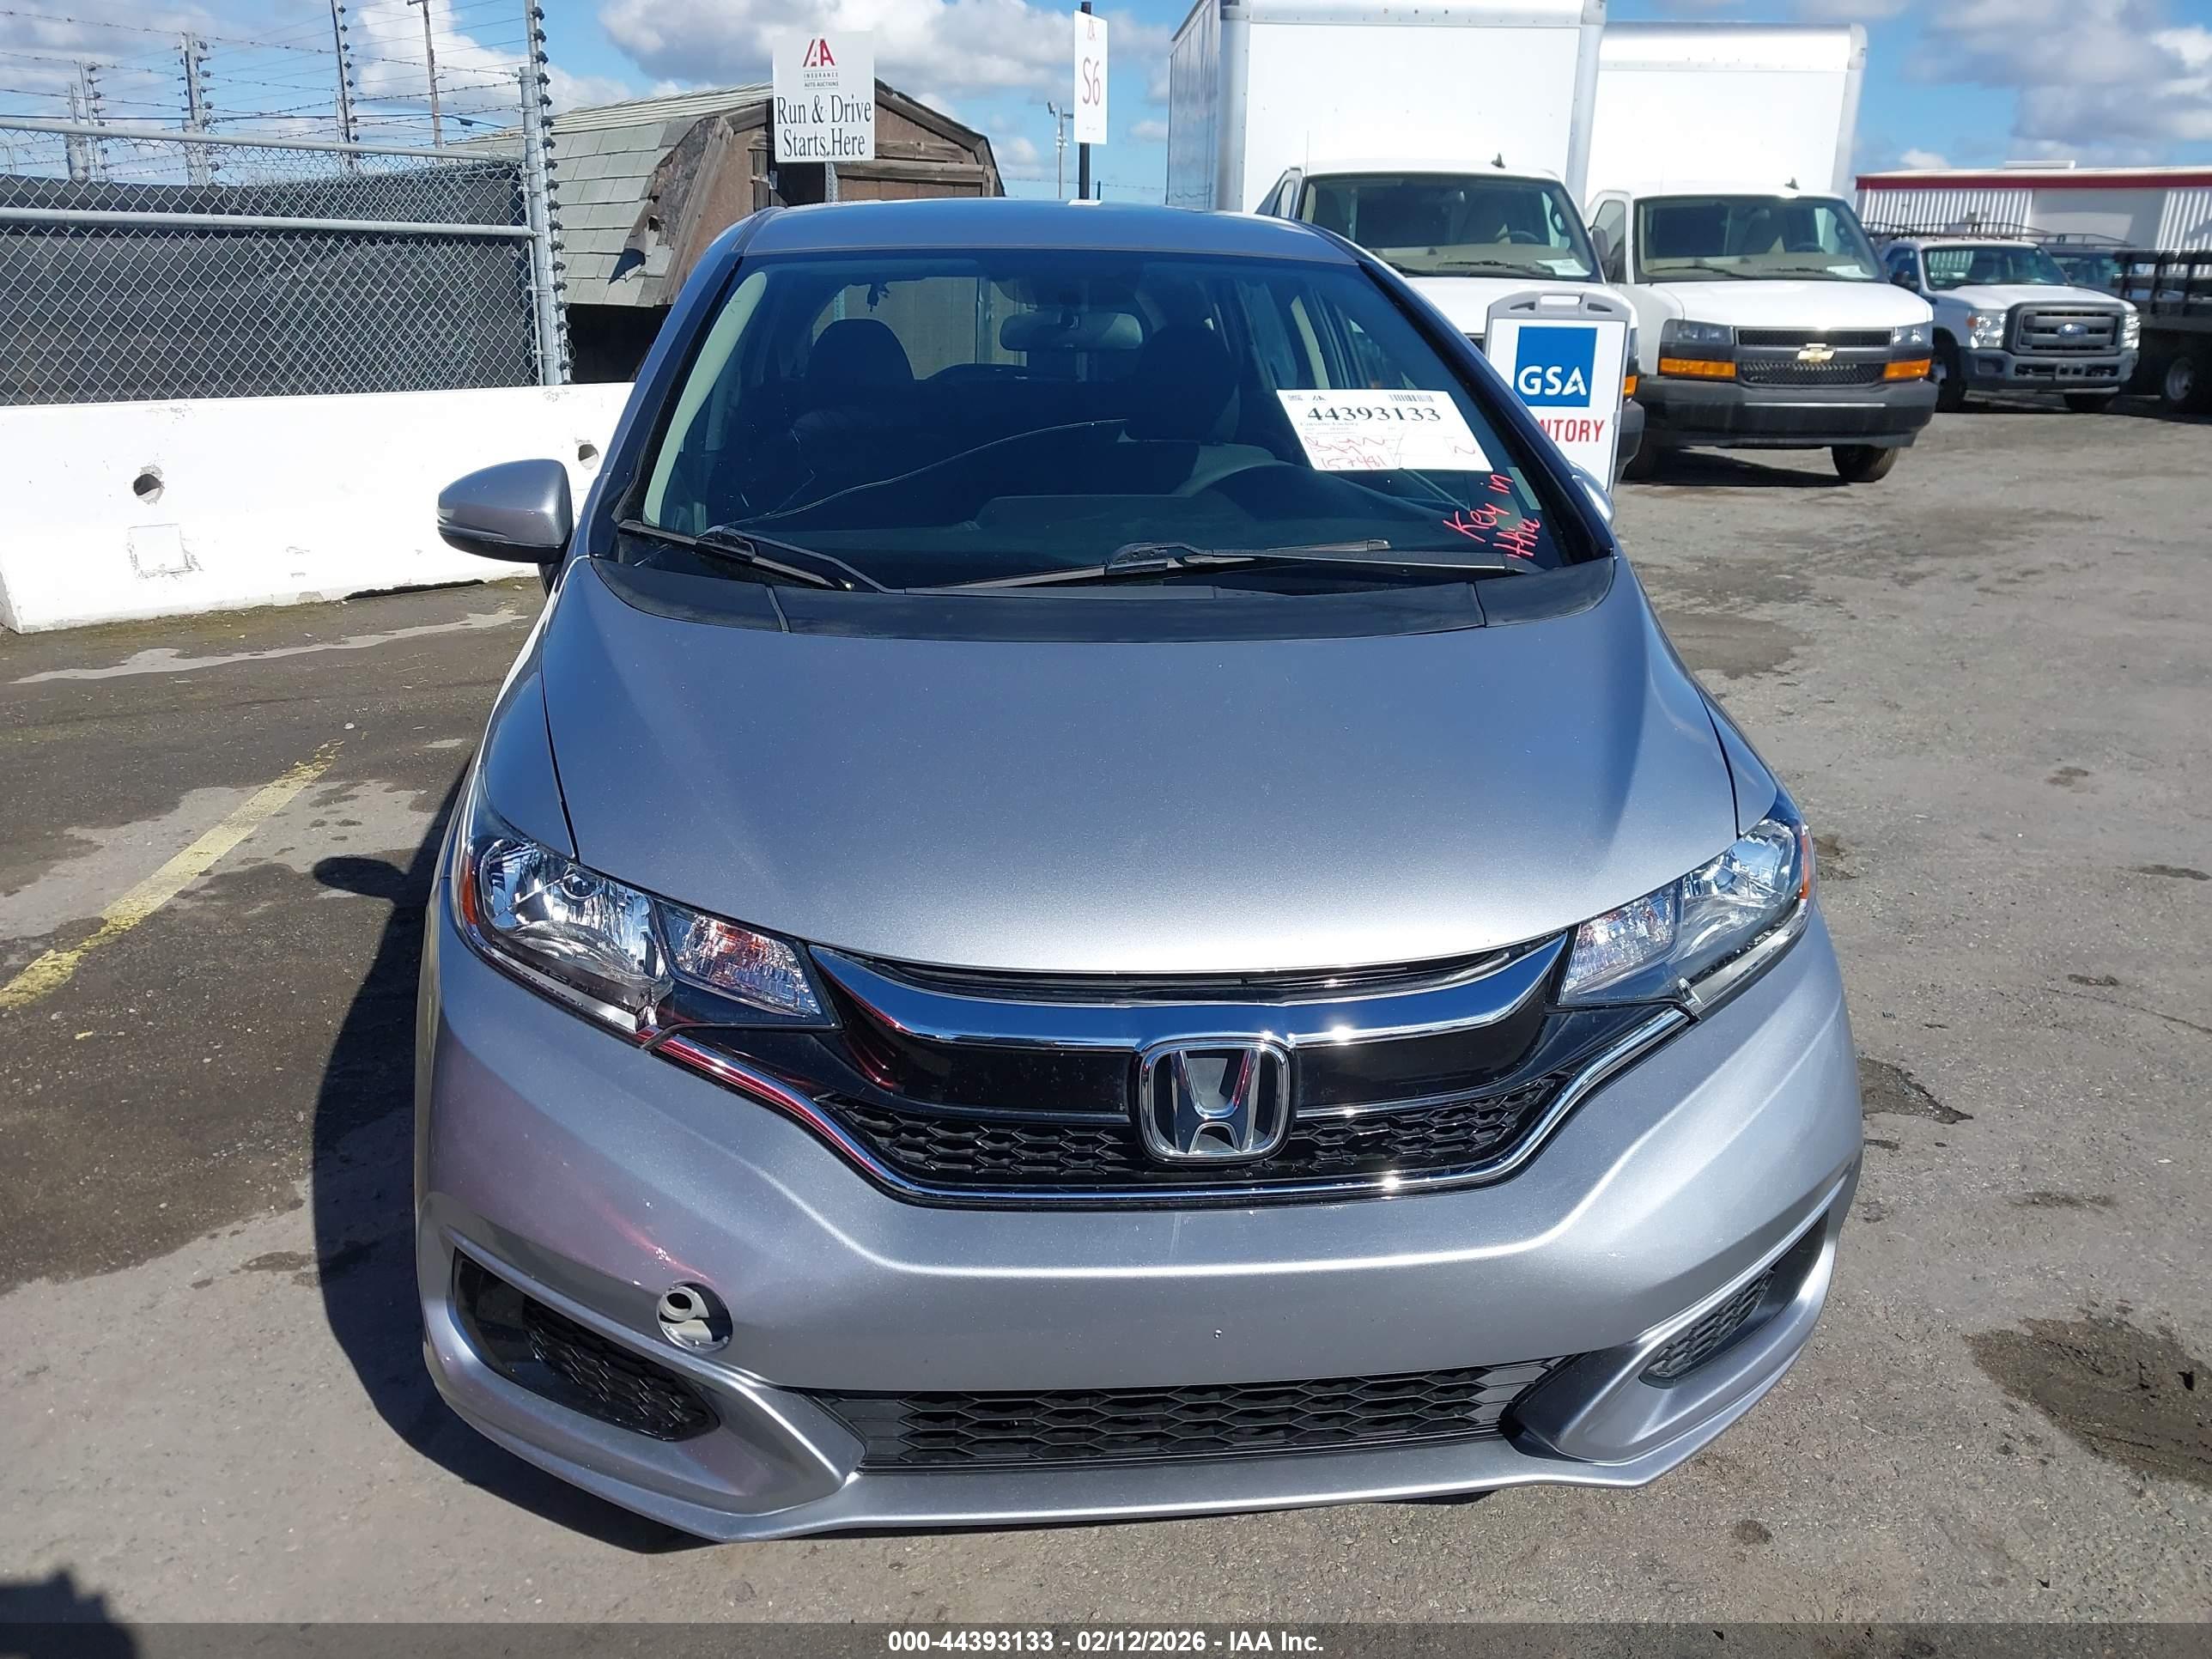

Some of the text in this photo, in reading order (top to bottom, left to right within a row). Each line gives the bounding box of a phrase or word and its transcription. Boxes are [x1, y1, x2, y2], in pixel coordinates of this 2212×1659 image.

[1082, 56, 1101, 106] S6
[775, 94, 872, 125] Run & Drive
[783, 127, 866, 157] Starts Here
[1517, 365, 1588, 396] GSA
[1307, 406, 1441, 422] 44393133
[1539, 419, 1606, 442] NTORY
[1443, 474, 1514, 543] Key in
